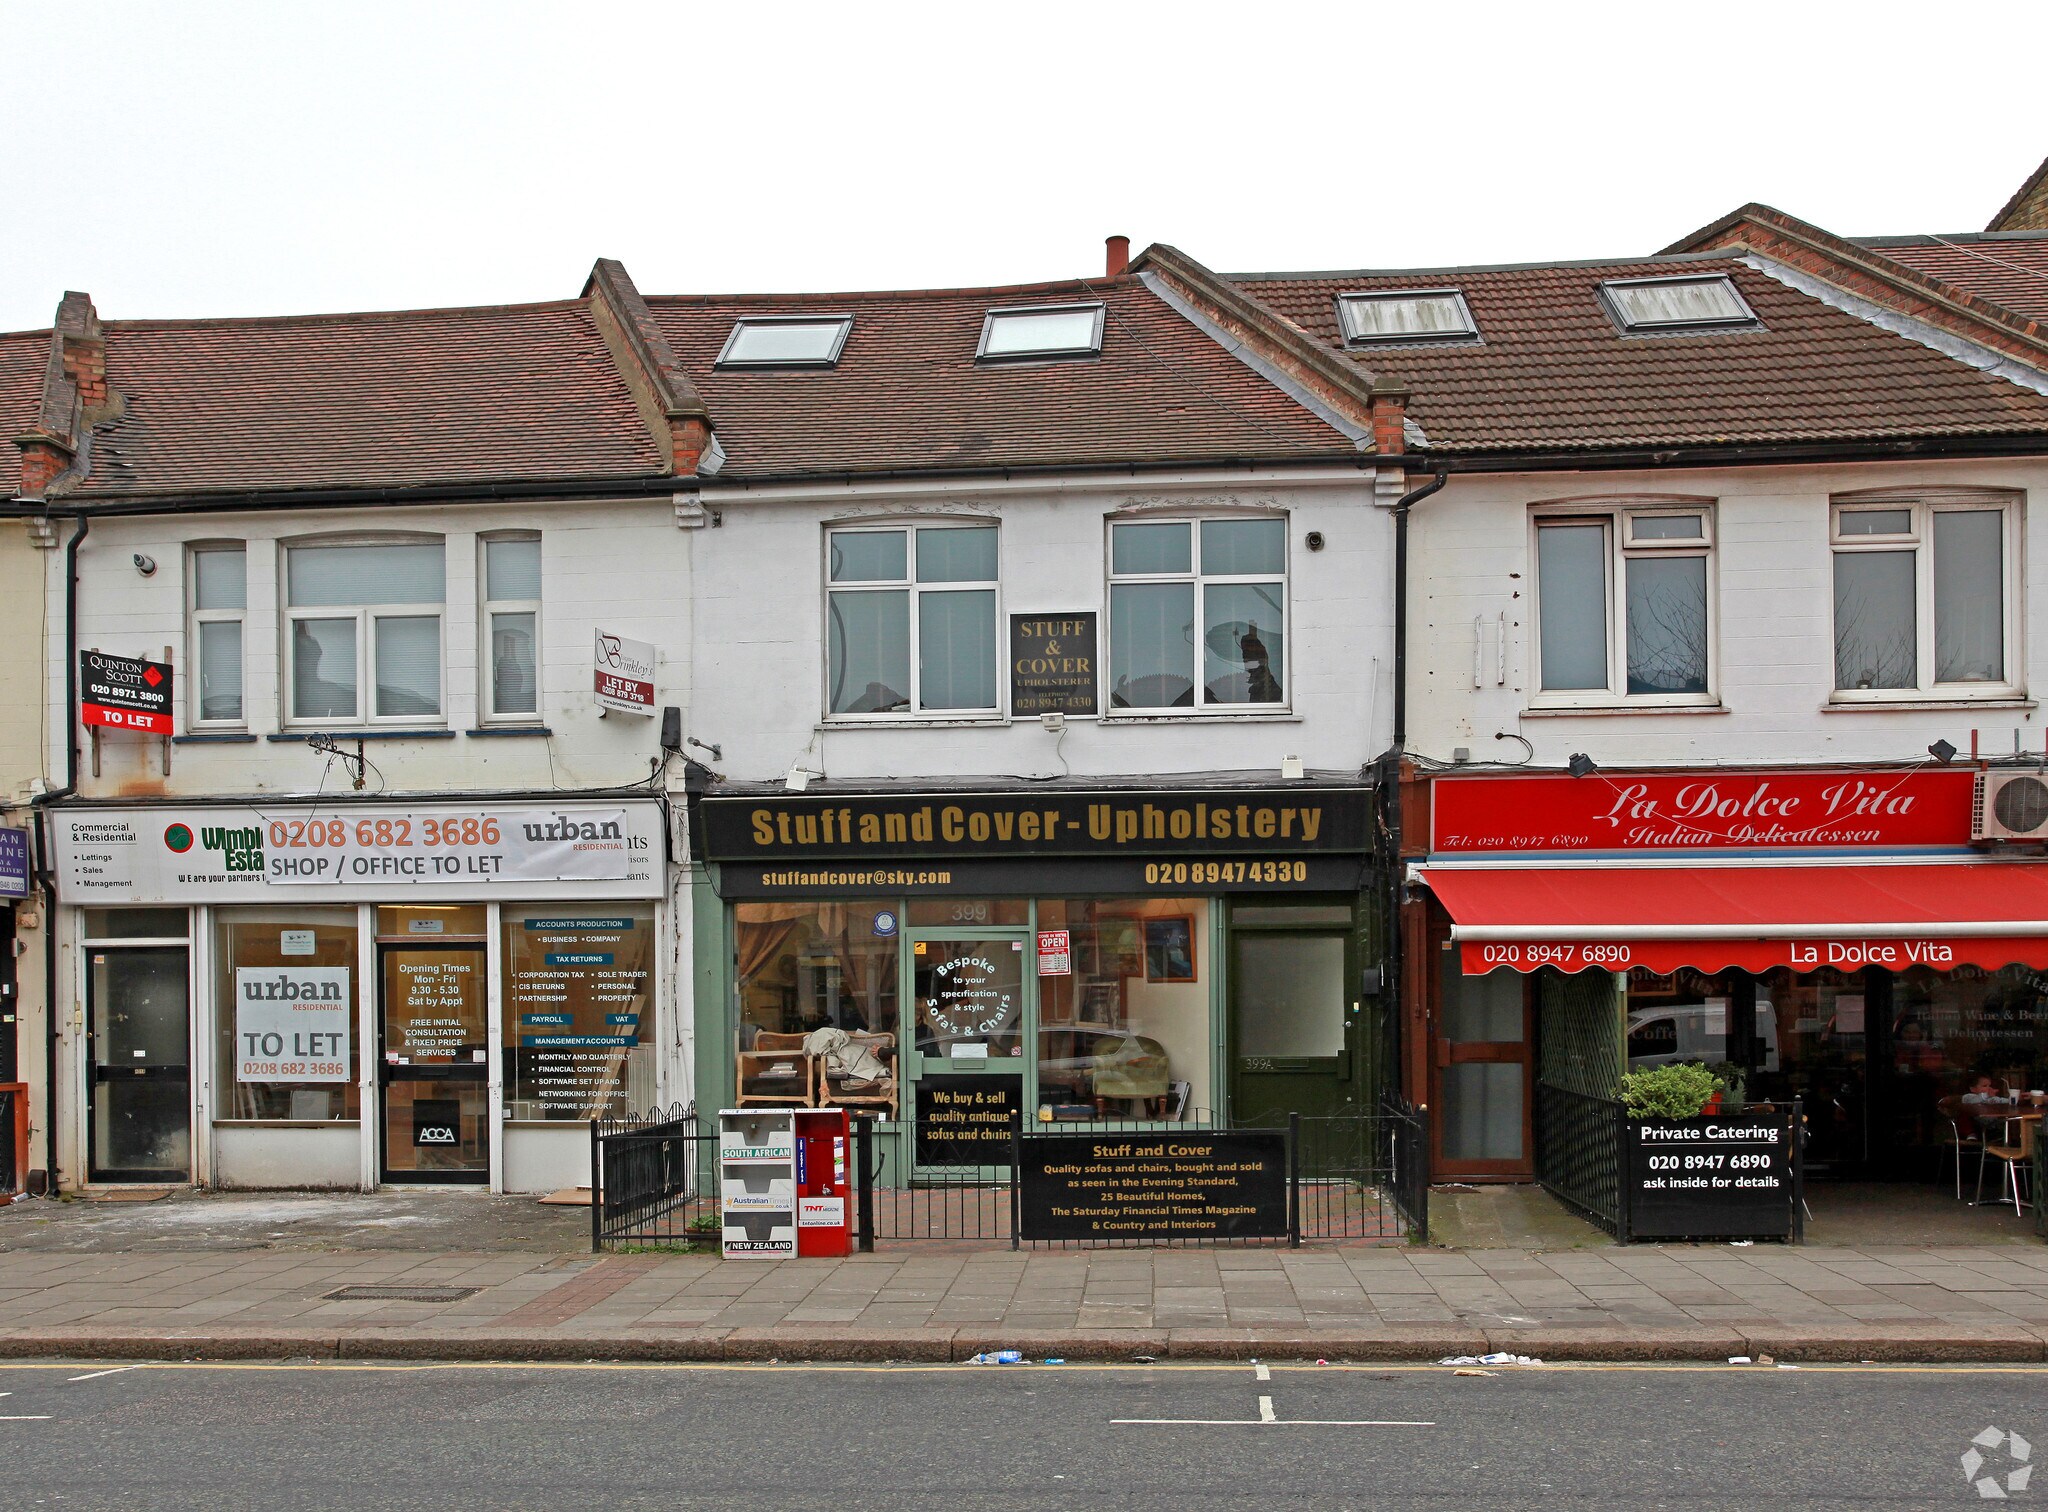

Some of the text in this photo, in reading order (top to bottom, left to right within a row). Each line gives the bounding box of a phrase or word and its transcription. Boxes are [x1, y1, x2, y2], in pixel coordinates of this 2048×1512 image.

[1021, 621, 1086, 637] STUFF
[1046, 640, 1061, 655] &
[90, 656, 142, 673] QUINTON
[1017, 658, 1090, 674] COVER
[106, 669, 142, 684] SCOTT
[1017, 678, 1090, 687] UPHOLSTERER
[606, 676, 638, 693] LET BY
[91, 684, 109, 695] 020
[113, 688, 137, 699] 8971
[140, 692, 164, 703] 3800
[1017, 697, 1091, 708] 020 8947 4330
[103, 711, 153, 727] TO LET
[1593, 781, 1919, 827] La Dolce Vita
[72, 823, 129, 832] Commercial
[523, 816, 622, 841] urban
[751, 809, 851, 845] Stuff
[860, 807, 933, 842] and
[941, 806, 1060, 842] Cover
[1088, 804, 1322, 843] Upholstery
[73, 834, 136, 842] & Residential
[269, 818, 500, 847] 0208 682 3686
[1623, 823, 1881, 845] Italian Delicatessen
[573, 843, 623, 851] RESIDENTIAL
[1444, 834, 1588, 848] Tel: 020 8947 6890
[82, 854, 112, 862] Lettings
[272, 856, 503, 879] SHOP / OFFICE TO LET
[84, 880, 132, 888] Management
[762, 870, 951, 886] stuffandcover@sky.com
[952, 904, 986, 921] 399
[1041, 938, 1065, 947] OPEN
[1484, 945, 1631, 962] 020 8947 6890
[1791, 942, 1953, 963] La Dolce Vita
[400, 964, 471, 974] Opening Times
[937, 957, 996, 976] Bespoke
[244, 975, 342, 1000] urban
[965, 977, 986, 985] your
[941, 990, 998, 998] specification
[408, 997, 463, 1007] Sat by Appt
[964, 1004, 985, 1012] style
[927, 994, 1010, 1036] Sofa's & Chairs
[244, 1032, 343, 1057] TO LET
[244, 1063, 343, 1075] 0208 682 3686
[933, 1091, 1005, 1106] We buy & sell
[419, 1128, 455, 1142] ACCA
[1641, 1125, 1778, 1142] Private Catering
[724, 1149, 790, 1157] SOUTH AFRICAN
[1093, 1145, 1212, 1157] Stuff and Cover
[1044, 1163, 1262, 1174] Quality sofas and chairs, bought and sold
[1650, 1155, 1770, 1169] 020 8947 6890
[1110, 1178, 1119, 1187] in
[1122, 1178, 1139, 1187] the
[1143, 1178, 1184, 1189] Evening
[1187, 1177, 1239, 1187] Standard,
[1644, 1176, 1779, 1188] ask inside for details
[1101, 1192, 1206, 1201] 25 Beautiful Homes,
[1051, 1206, 1257, 1218] The Saturday Financial Times Magazine
[1092, 1220, 1216, 1232] & Country and Interiors
